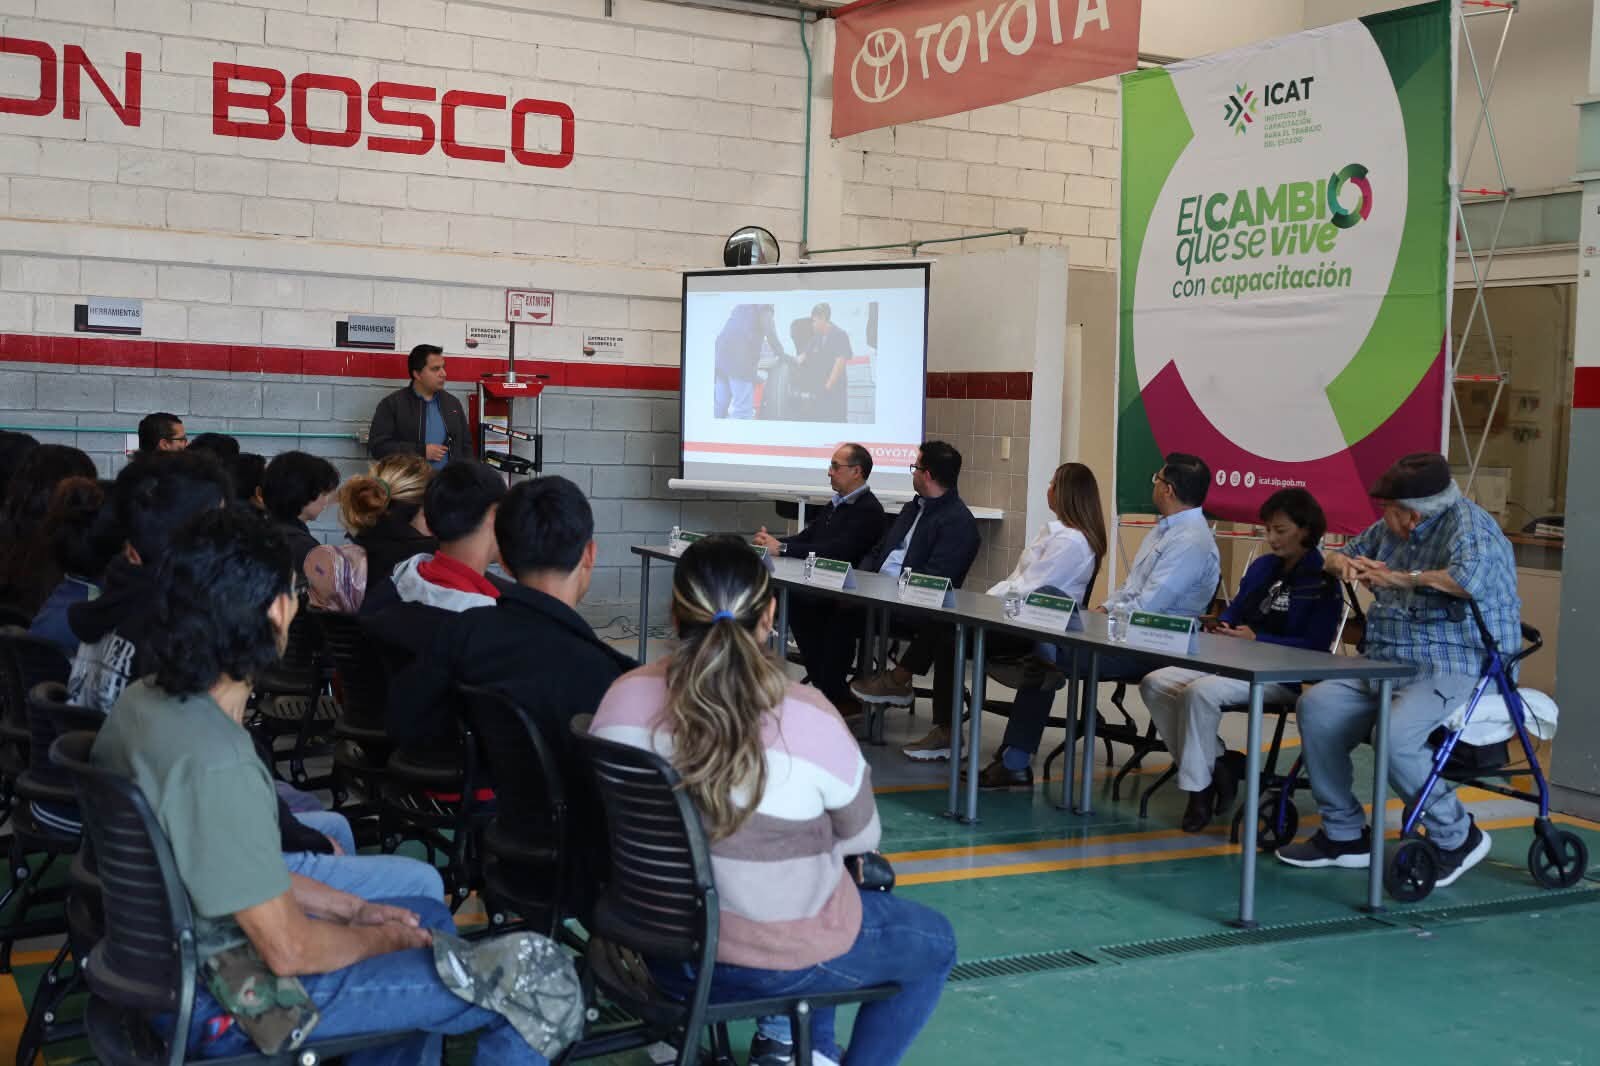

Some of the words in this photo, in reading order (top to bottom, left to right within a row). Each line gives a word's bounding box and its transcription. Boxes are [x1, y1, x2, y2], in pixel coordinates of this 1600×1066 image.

[915, 0, 1110, 79] TOYOTA
[1264, 76, 1314, 107] ICAT
[212, 61, 575, 169] BOSCO
[1264, 111, 1296, 122] INSTITUTO
[1264, 130, 1281, 139] PARA
[1292, 124, 1322, 135] TRABAJO
[1177, 194, 1203, 236] El
[1204, 163, 1372, 232] CAMBIO
[1176, 226, 1230, 276] que
[1231, 229, 1267, 260] se
[1271, 221, 1339, 256] vive
[1172, 277, 1206, 299] con
[1210, 261, 1353, 299] capacitación
[89, 307, 141, 318] HERRAMIENTAS
[525, 295, 551, 307] EXTINTOR
[349, 324, 396, 334] HERRAMIENTAS
[869, 447, 917, 457] TOYOTA
